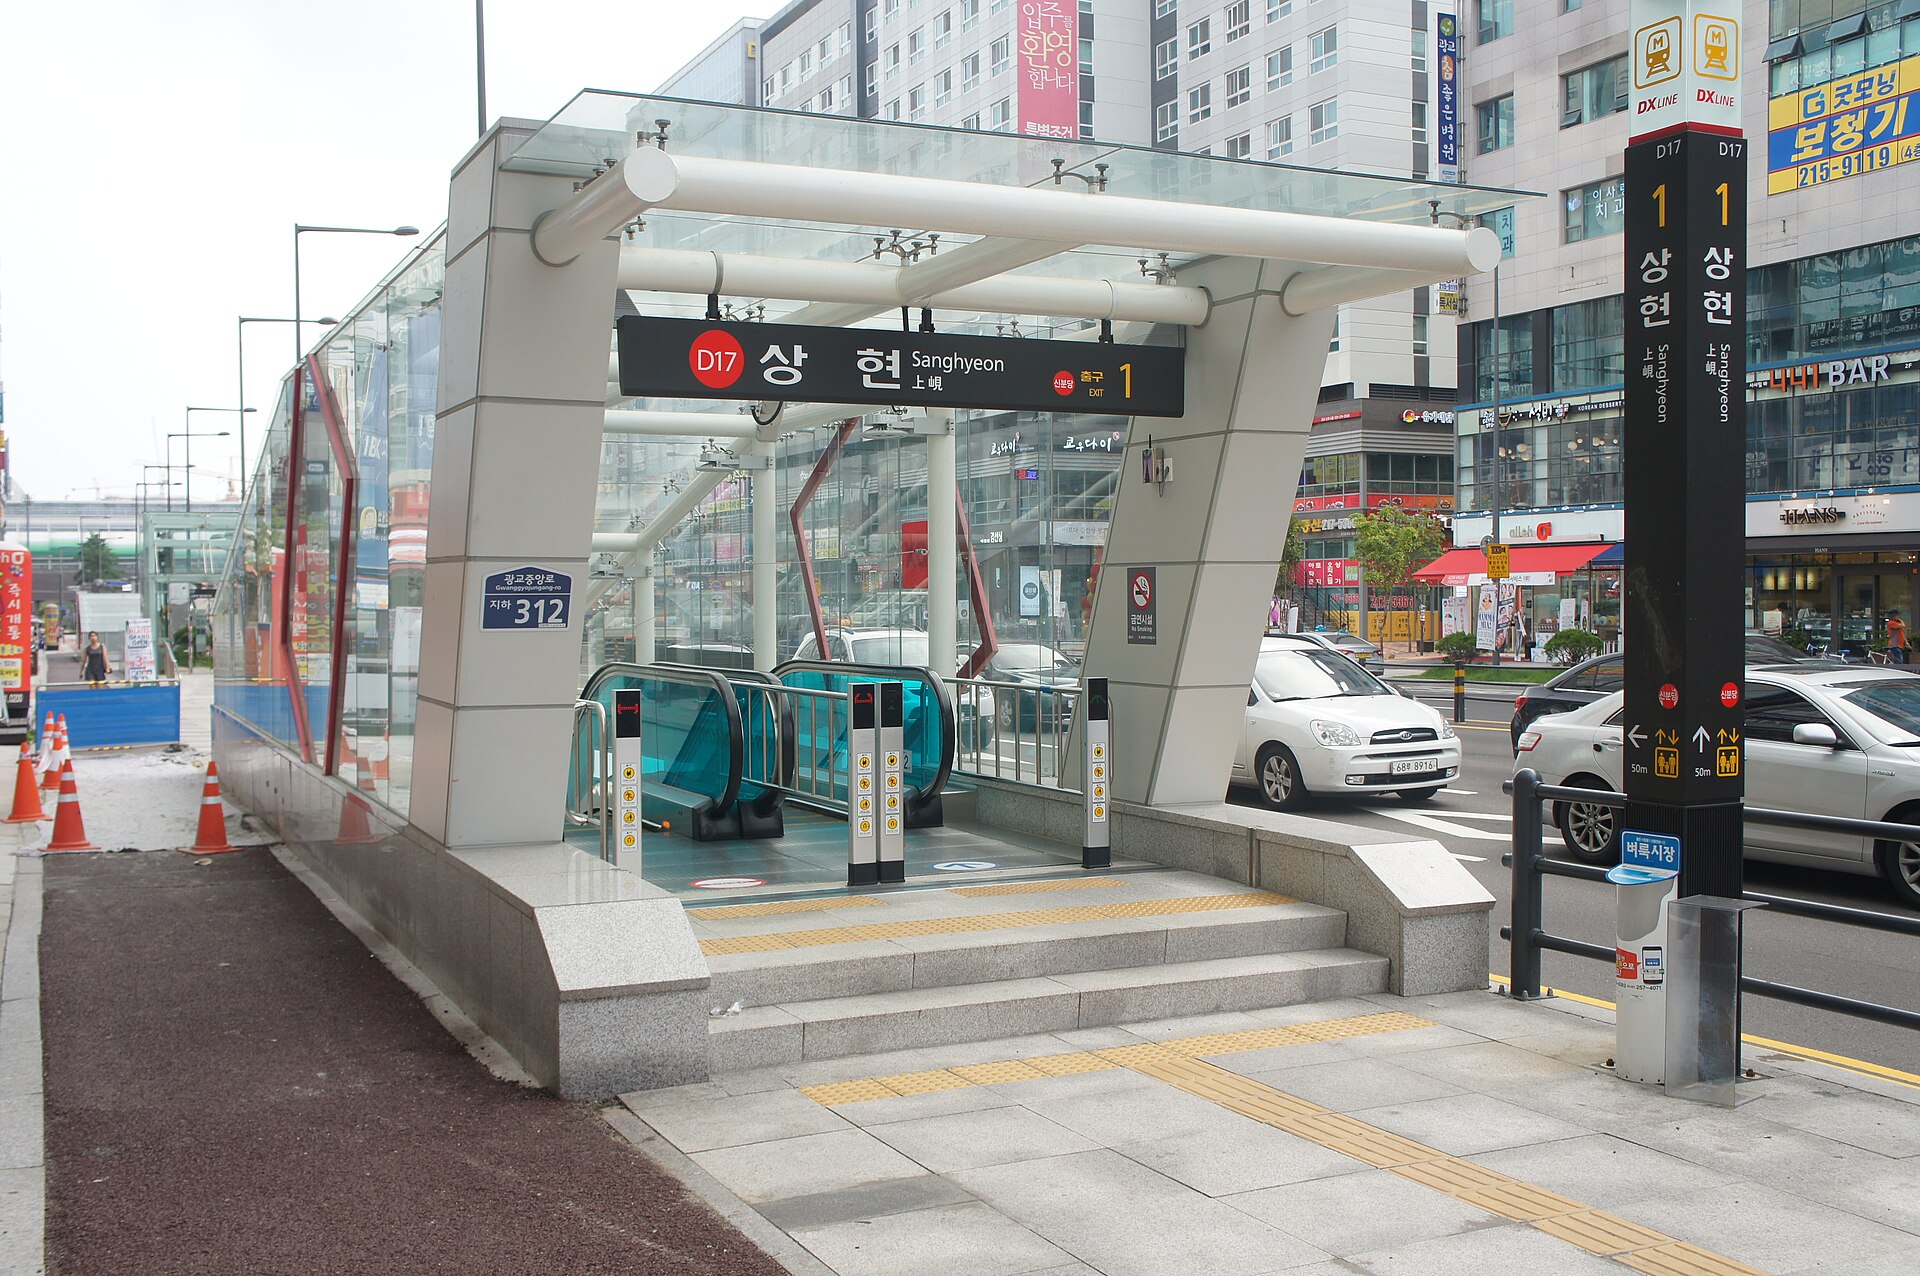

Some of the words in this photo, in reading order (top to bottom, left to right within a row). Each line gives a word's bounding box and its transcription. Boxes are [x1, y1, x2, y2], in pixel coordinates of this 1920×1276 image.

[1022, 1, 1074, 30] 입주를
[1019, 28, 1072, 69] 환영
[1438, 38, 1456, 53] 광교
[1027, 67, 1075, 94] 합니다
[1834, 69, 1897, 110] 굿모닝
[1790, 96, 1909, 162] 보청기
[1656, 139, 1682, 160] D17
[1719, 141, 1742, 158] D17
[1799, 146, 1890, 187] 215-9119
[1596, 197, 1625, 219] 치과
[1652, 184, 1666, 227] 1
[1715, 183, 1728, 226] 1
[1501, 212, 1513, 252] 치과
[1640, 248, 1672, 328] 상현
[1703, 246, 1733, 325] 상현
[697, 350, 737, 372] D17
[912, 350, 1005, 374] Sanghyeon
[912, 375, 943, 393] 上峴
[1053, 378, 1074, 390] 신분당
[1080, 370, 1104, 384] 출구
[1119, 363, 1132, 398] 1
[1655, 344, 1669, 423] Sanghyeon
[1719, 343, 1731, 423] Sanghyeon
[1769, 363, 1820, 393] 441
[1828, 355, 1891, 388] BAR
[1088, 387, 1104, 398] EXIT
[1528, 402, 1554, 422] 설빙
[1578, 403, 1598, 412] KOREAN
[1599, 401, 1622, 409] DESSERT
[1783, 507, 1837, 526] HANS
[1509, 525, 1534, 538] olleh
[503, 574, 555, 585] 광교중앙로
[5, 583, 21, 640] 즉시개통
[490, 599, 512, 610] 지하
[514, 598, 563, 624] 312
[1131, 614, 1152, 625] 금연시설
[1721, 689, 1738, 700] 신분당
[1414, 761, 1433, 771] 8916
[1631, 763, 1648, 774] 50m
[1695, 767, 1711, 777] 50m
[1626, 841, 1676, 863] 벼룩시장
